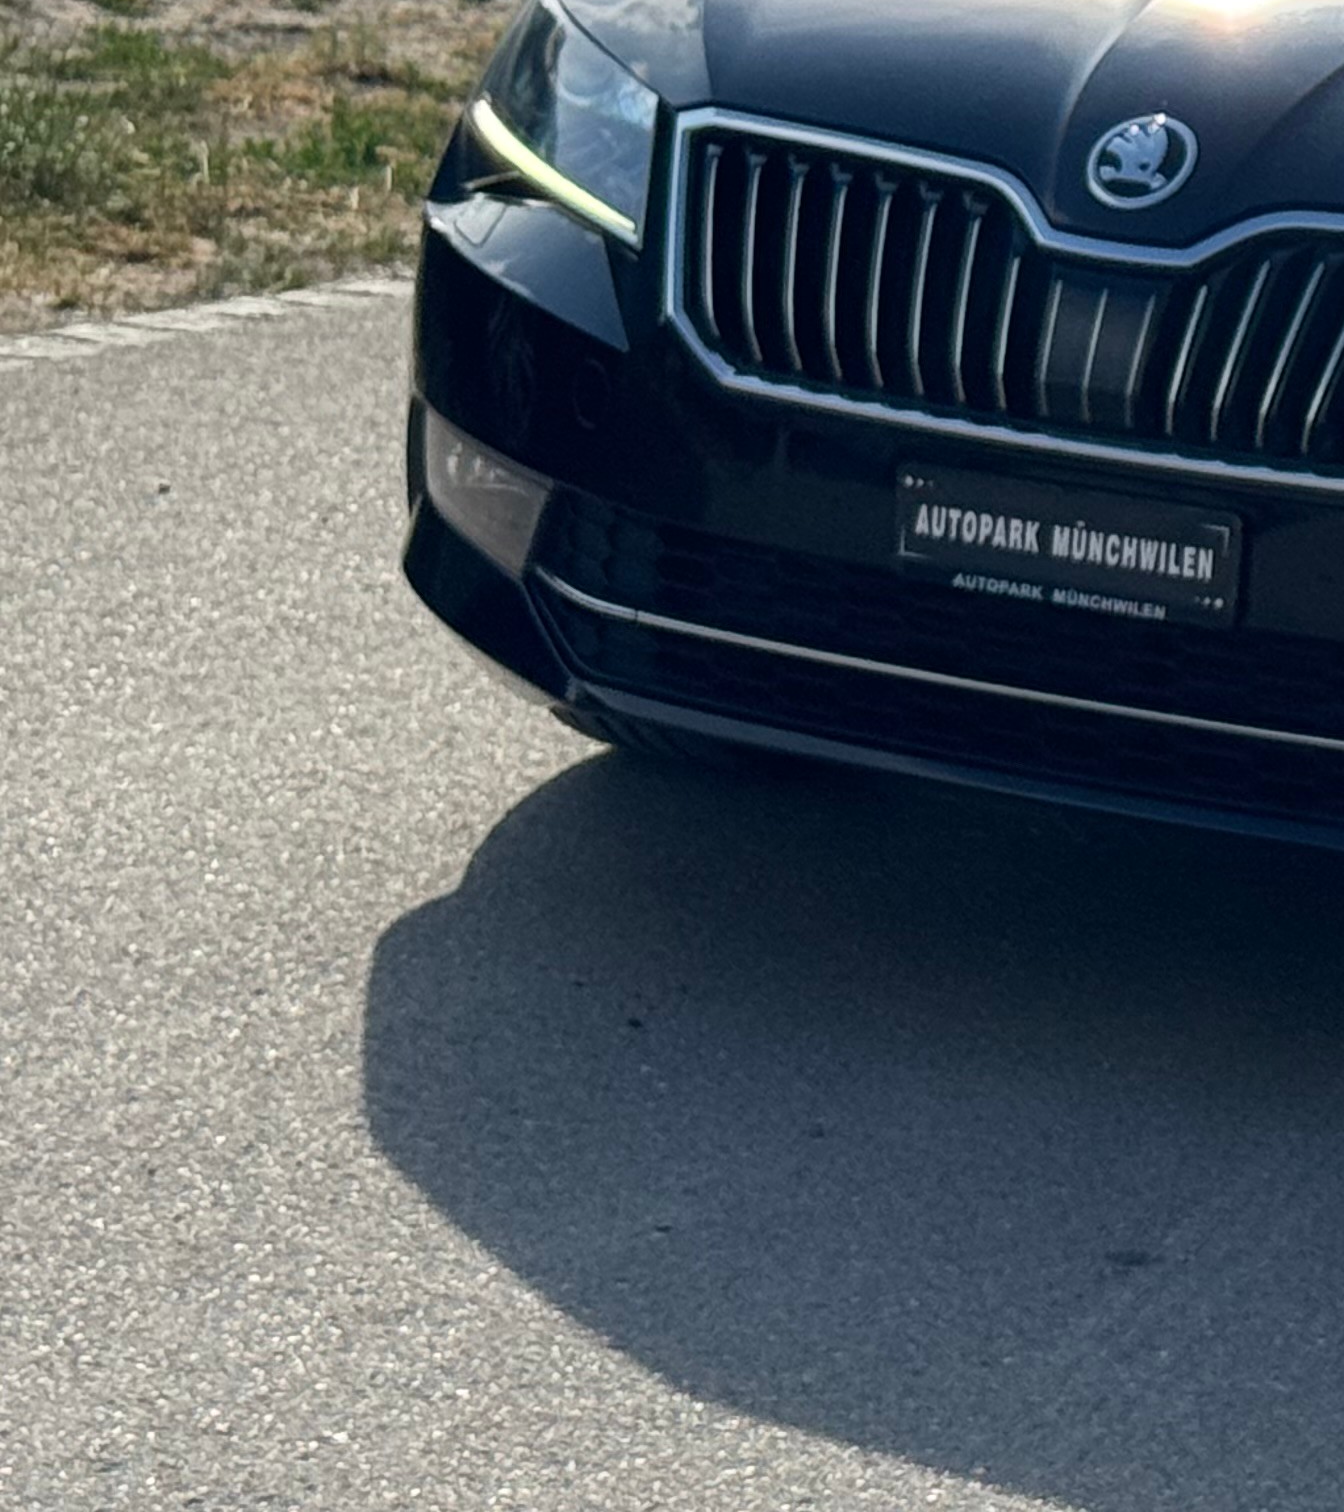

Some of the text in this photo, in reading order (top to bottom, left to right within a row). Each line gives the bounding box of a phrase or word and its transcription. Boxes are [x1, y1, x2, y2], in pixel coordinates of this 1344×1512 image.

[915, 503, 1214, 581] AUTOPARK MÜNCHWILEN
[953, 571, 1167, 621] AUTOPARK MÜNCHWILEN
